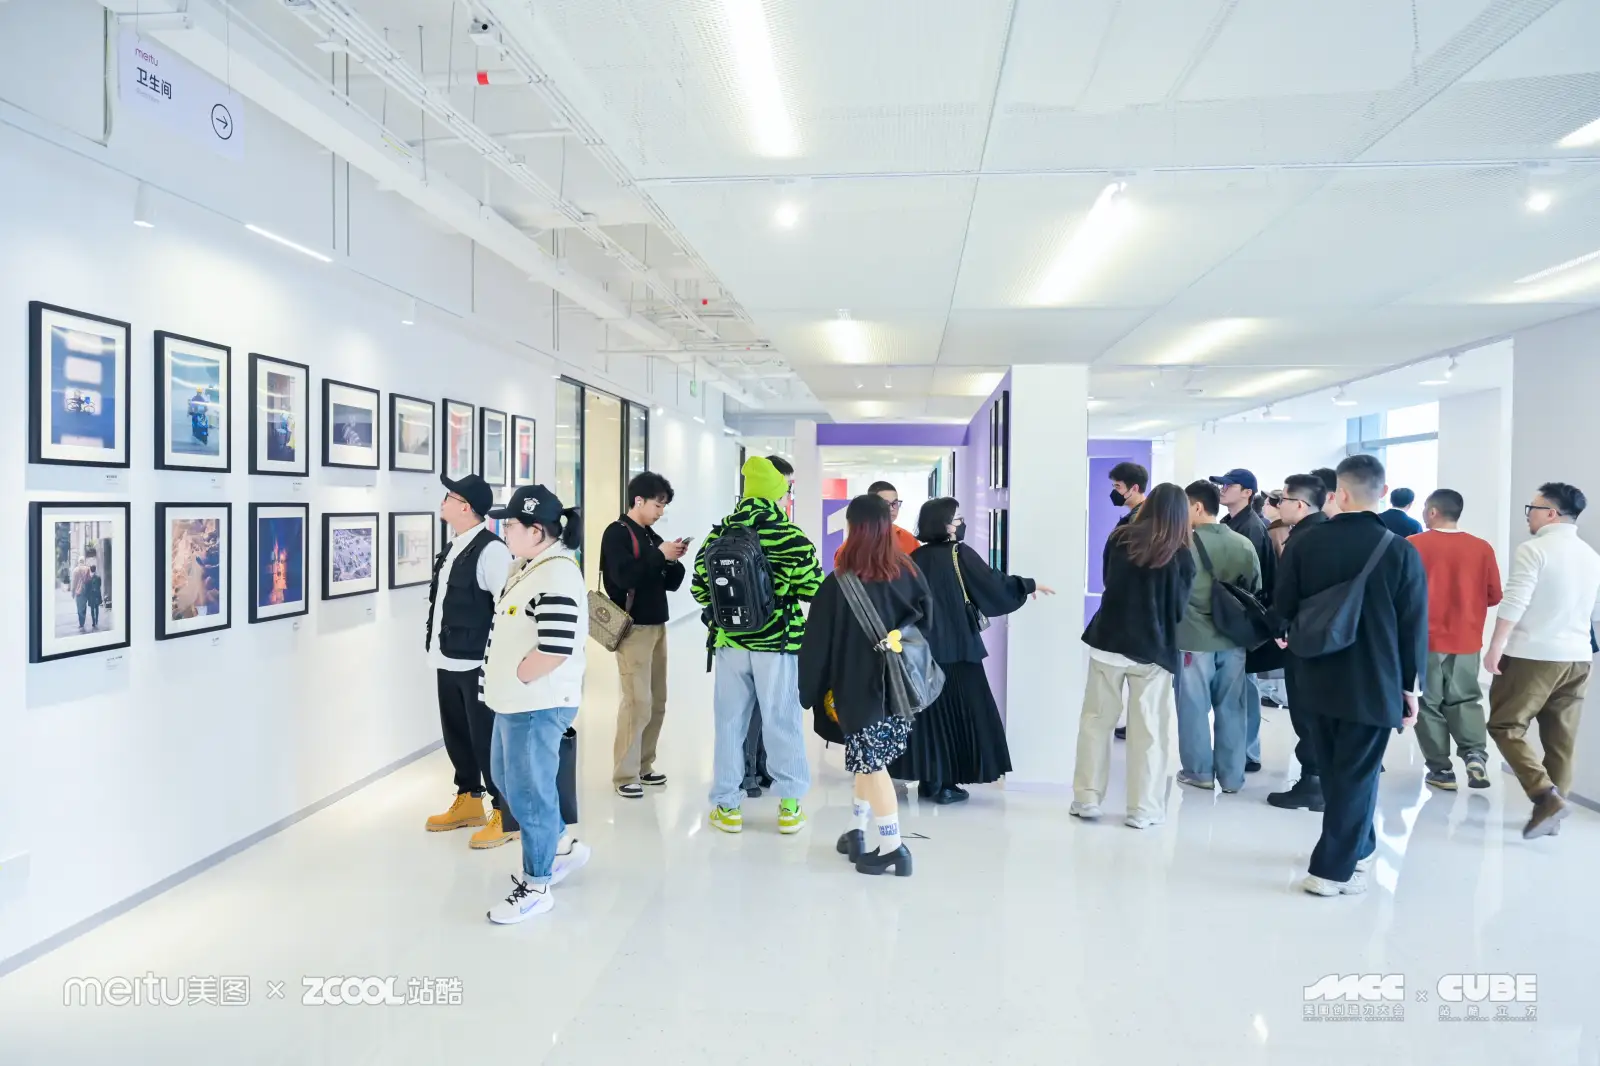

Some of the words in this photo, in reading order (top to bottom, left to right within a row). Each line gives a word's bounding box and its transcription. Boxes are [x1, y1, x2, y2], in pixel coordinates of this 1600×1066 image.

[135, 48, 159, 67] meitu
[136, 66, 172, 100] 卫生间
